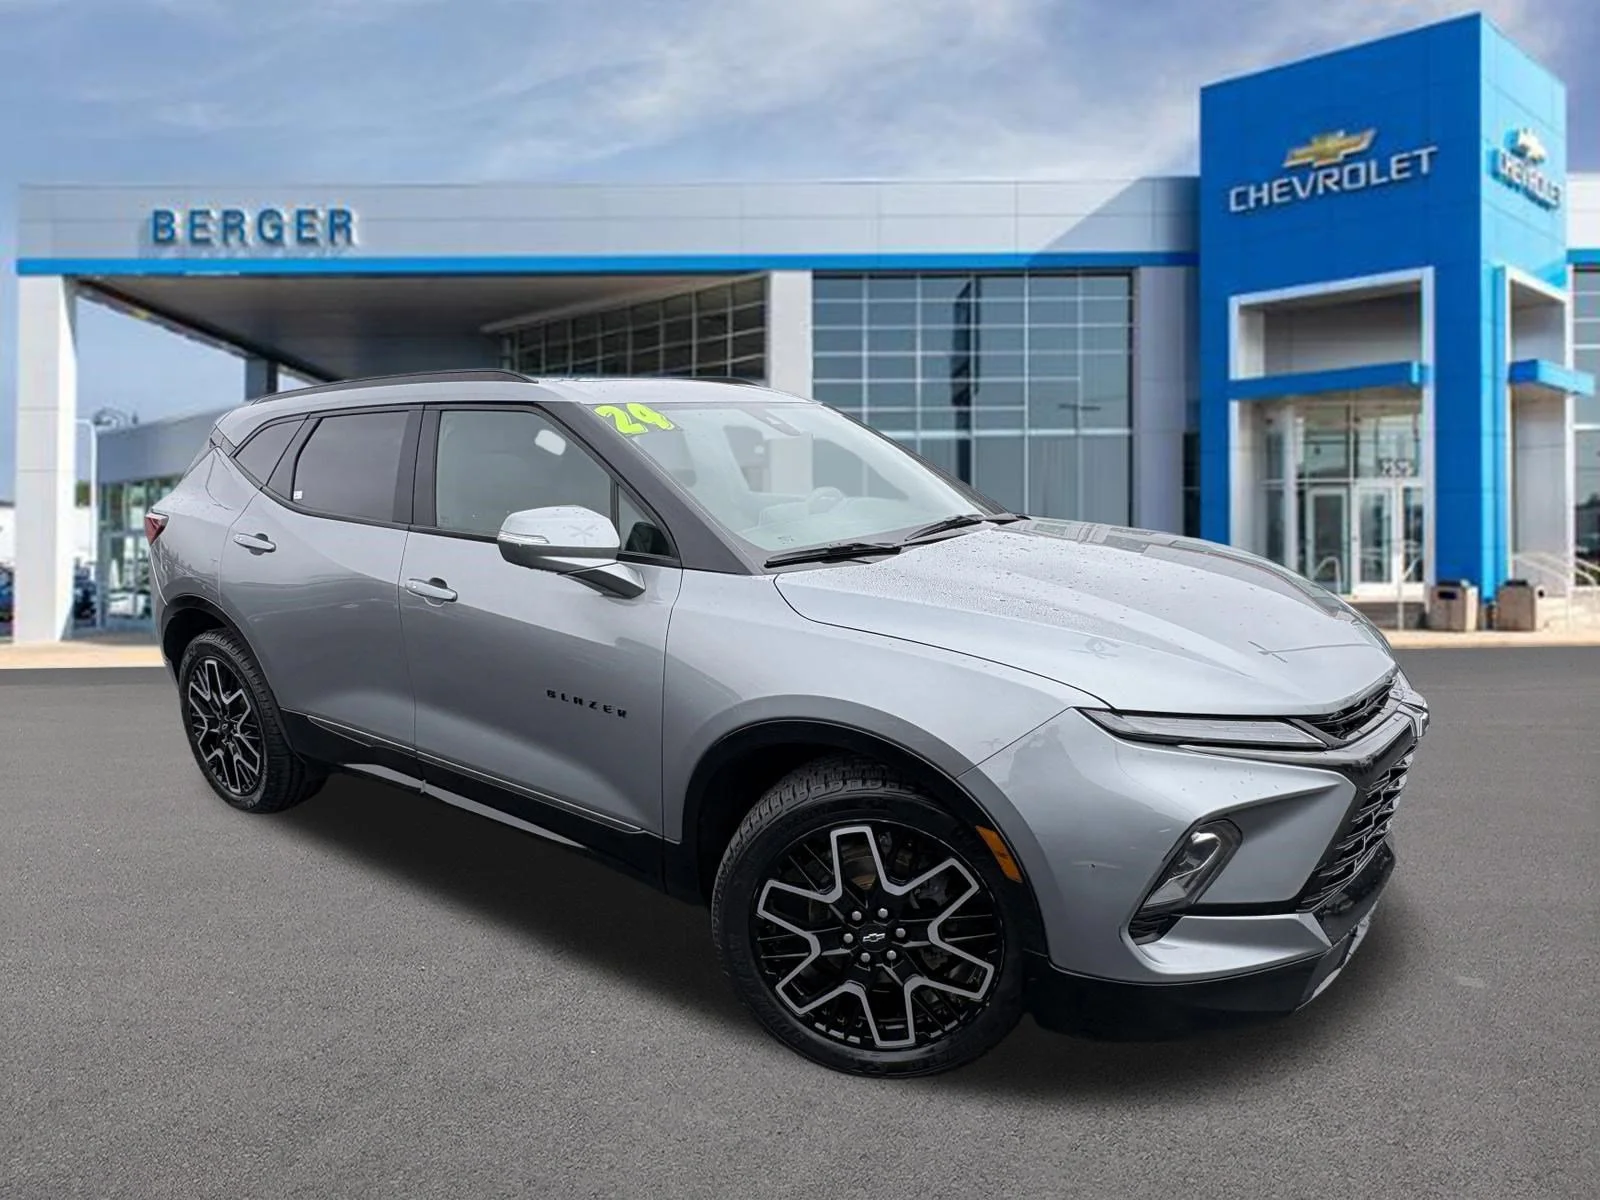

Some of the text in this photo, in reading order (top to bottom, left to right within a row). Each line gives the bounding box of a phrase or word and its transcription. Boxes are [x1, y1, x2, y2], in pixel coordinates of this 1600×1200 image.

[1228, 146, 1438, 213] CHEVROLET
[152, 207, 356, 246] BERGER
[546, 689, 627, 718] BLAZER
